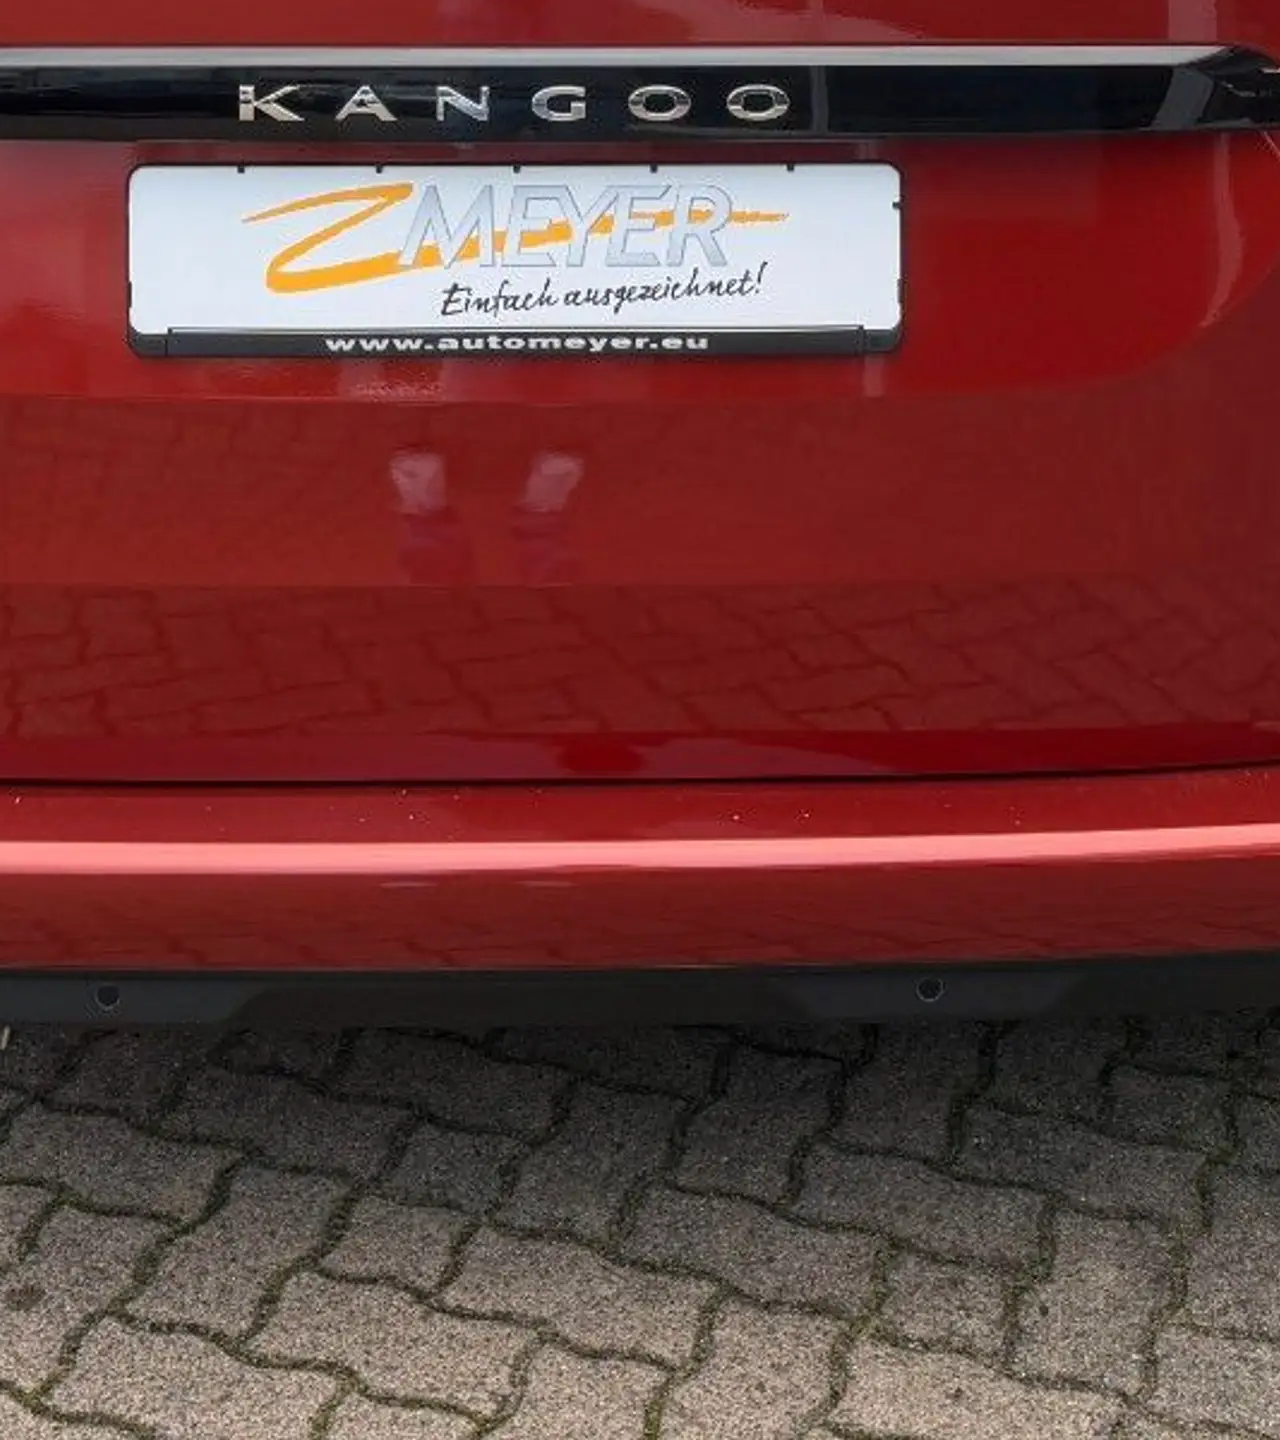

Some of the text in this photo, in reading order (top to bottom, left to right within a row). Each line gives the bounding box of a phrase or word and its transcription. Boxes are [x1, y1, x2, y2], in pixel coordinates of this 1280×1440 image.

[237, 84, 791, 123] KANGOO
[439, 261, 769, 317] Einfach ausgezeichnet!
[325, 333, 709, 353] www.automeyer.eu
